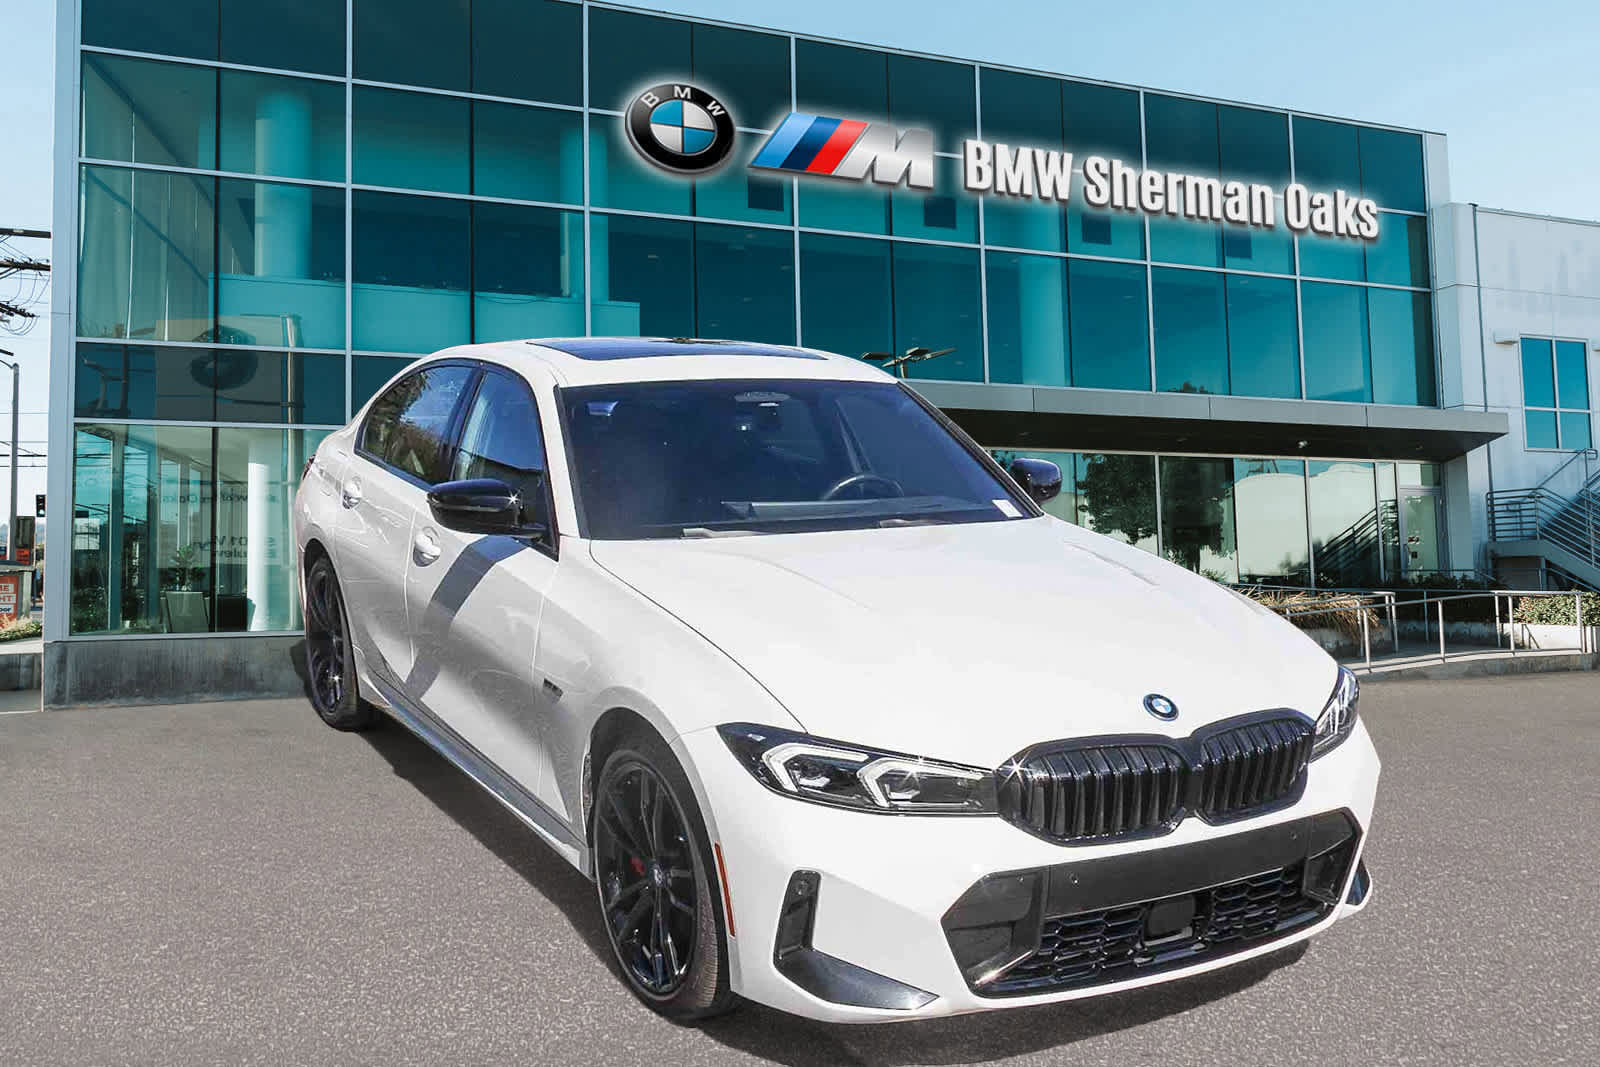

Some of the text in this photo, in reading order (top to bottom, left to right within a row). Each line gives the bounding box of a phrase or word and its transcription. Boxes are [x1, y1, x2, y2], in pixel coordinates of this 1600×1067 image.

[641, 85, 725, 117] BMW
[964, 138, 1379, 241] BMW Sherman Oaks
